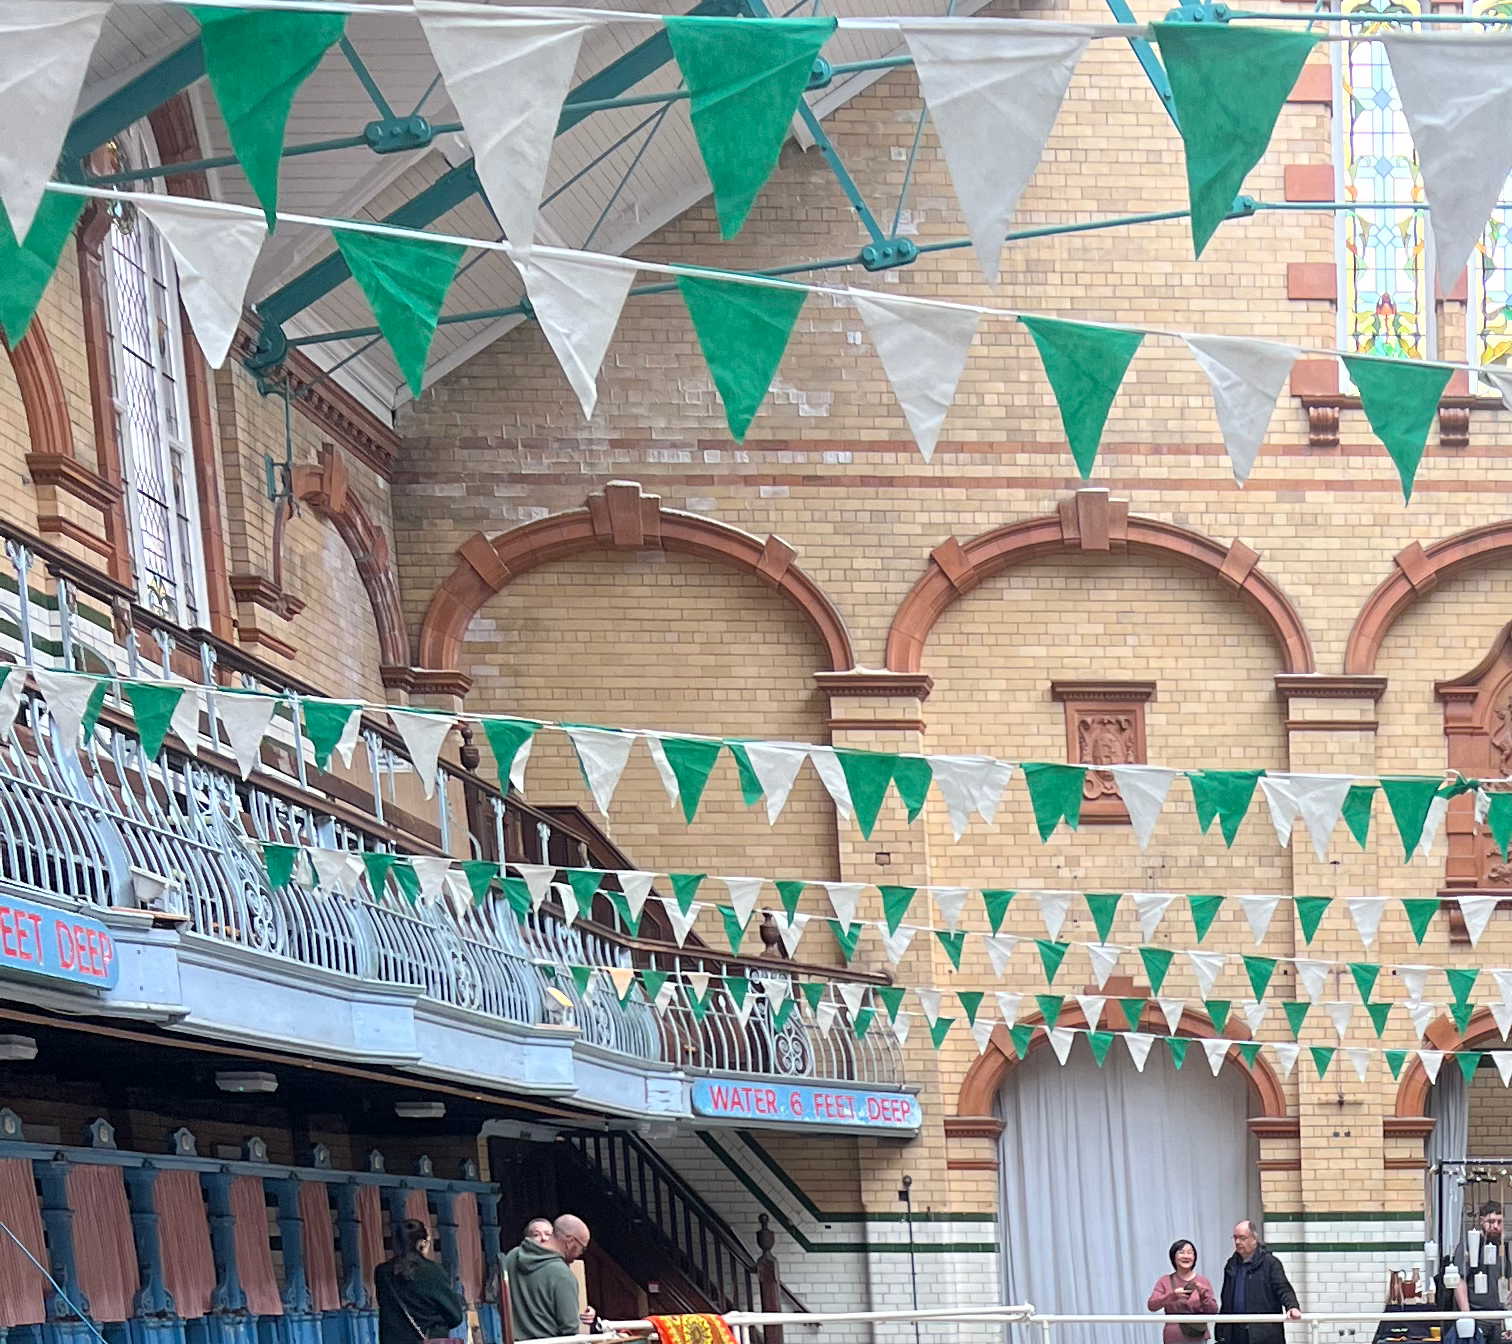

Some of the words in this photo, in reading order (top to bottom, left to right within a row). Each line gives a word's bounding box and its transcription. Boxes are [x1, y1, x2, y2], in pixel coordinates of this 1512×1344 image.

[55, 919, 113, 979] DEEP
[709, 1084, 779, 1115] WATER
[789, 1091, 804, 1117] 6
[813, 1093, 856, 1119] FEET
[867, 1097, 911, 1123] DEEP
